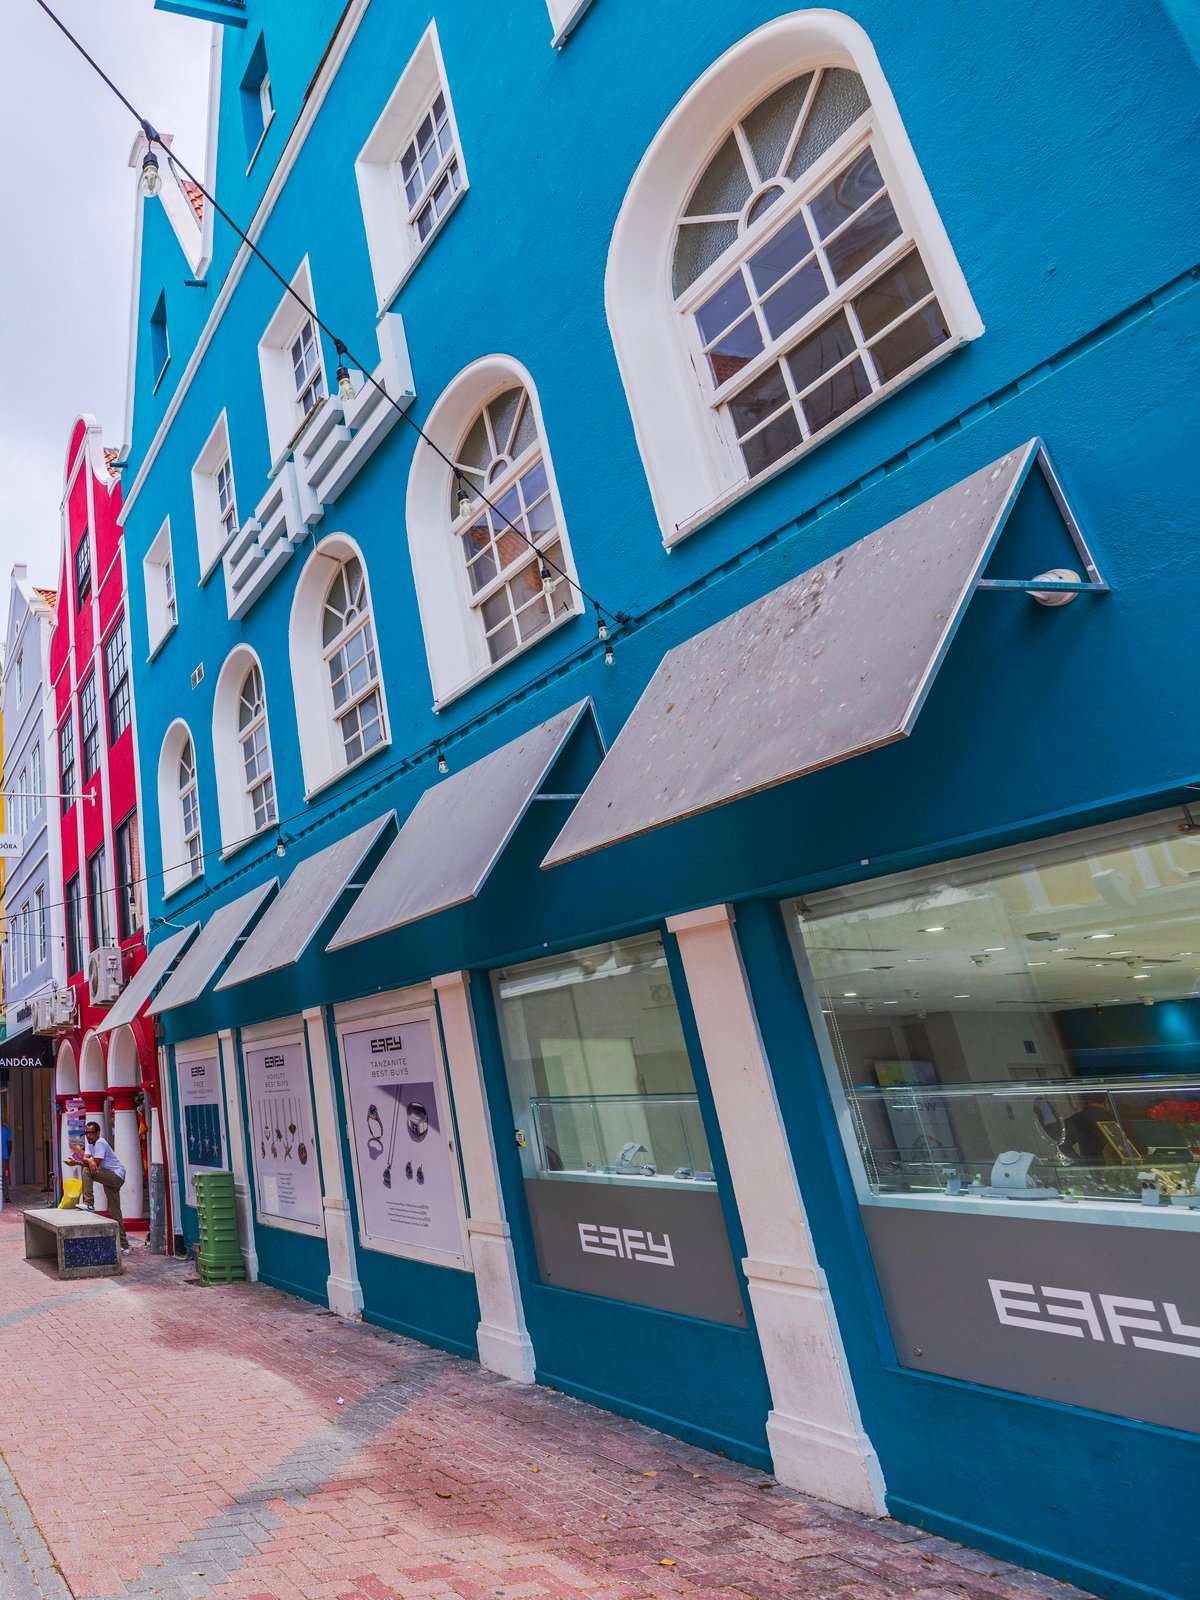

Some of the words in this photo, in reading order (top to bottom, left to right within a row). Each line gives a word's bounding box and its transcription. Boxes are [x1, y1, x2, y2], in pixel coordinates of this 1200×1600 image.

[222, 312, 416, 620] EFFY
[370, 1035, 402, 1053] EFFY
[264, 1054, 284, 1068] EFFY
[370, 1057, 407, 1068] TANZANITE
[191, 1066, 205, 1077] EFFY
[266, 1072, 285, 1080] NOVELTY
[371, 1069, 388, 1078] BEST
[390, 1067, 409, 1076] BUYS
[577, 1222, 675, 1267] EFFY
[987, 1278, 1200, 1358] EFFY
